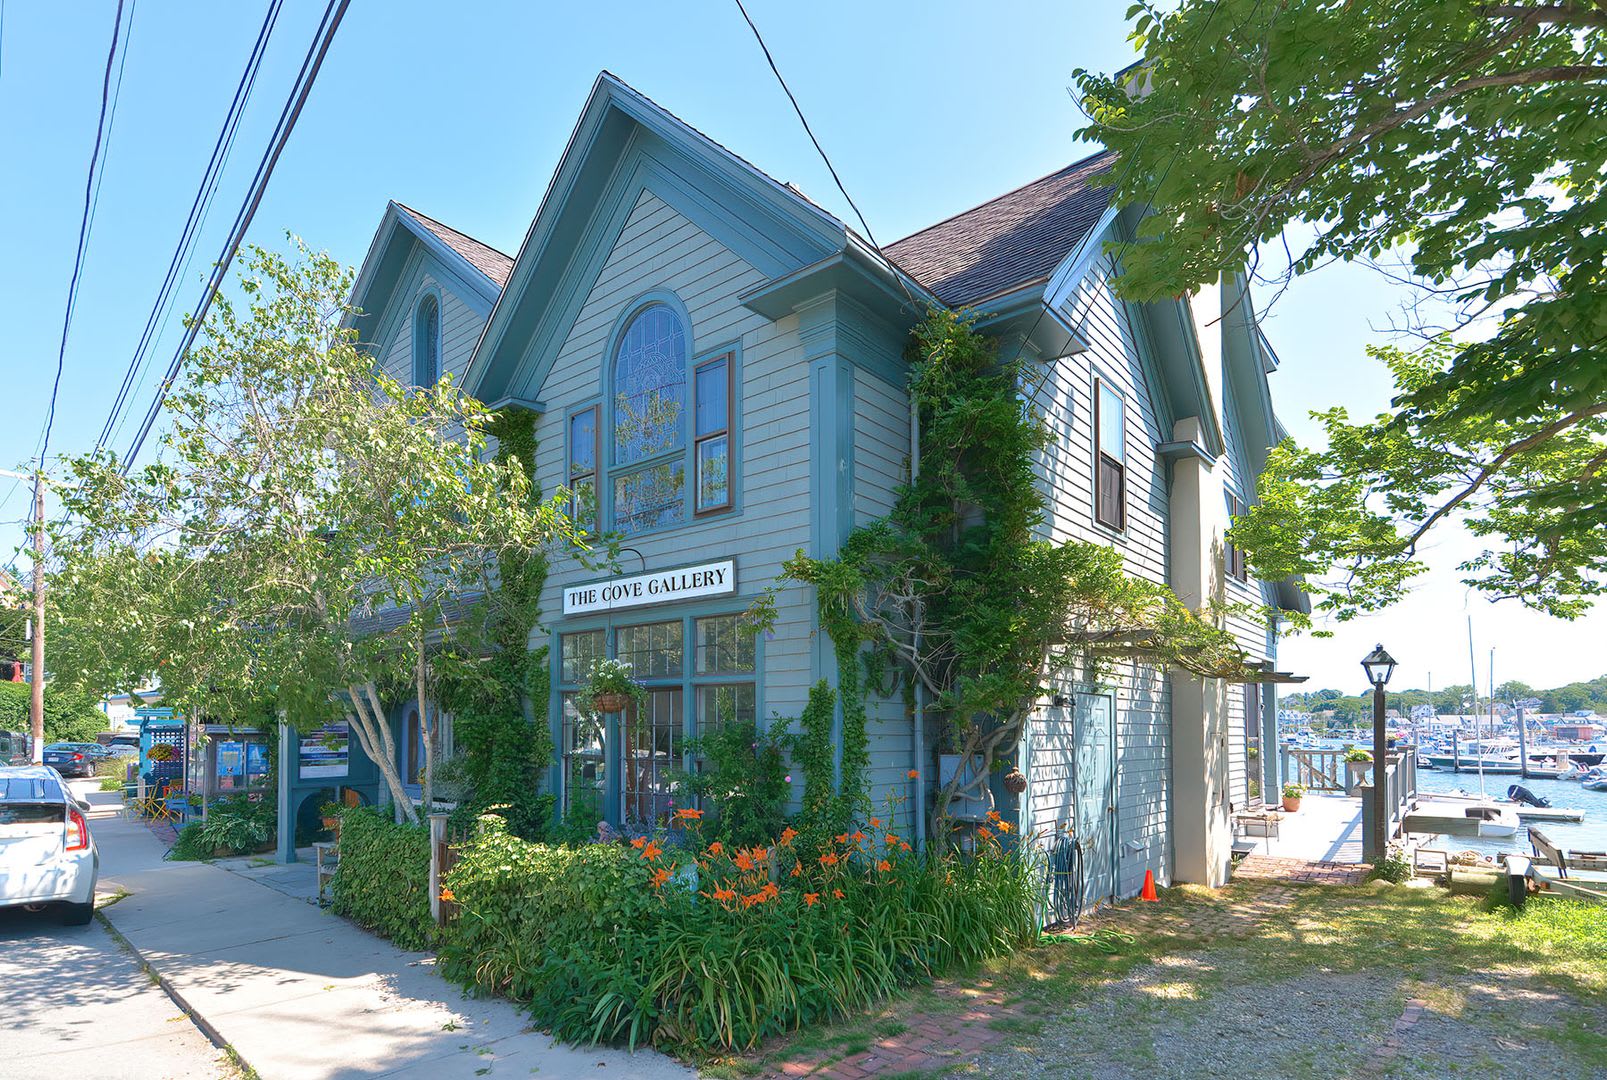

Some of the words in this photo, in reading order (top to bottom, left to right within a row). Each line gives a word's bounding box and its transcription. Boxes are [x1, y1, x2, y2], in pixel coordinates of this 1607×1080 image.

[569, 589, 597, 606] THE
[602, 582, 642, 602] COVE
[648, 568, 727, 595] GALLERY
